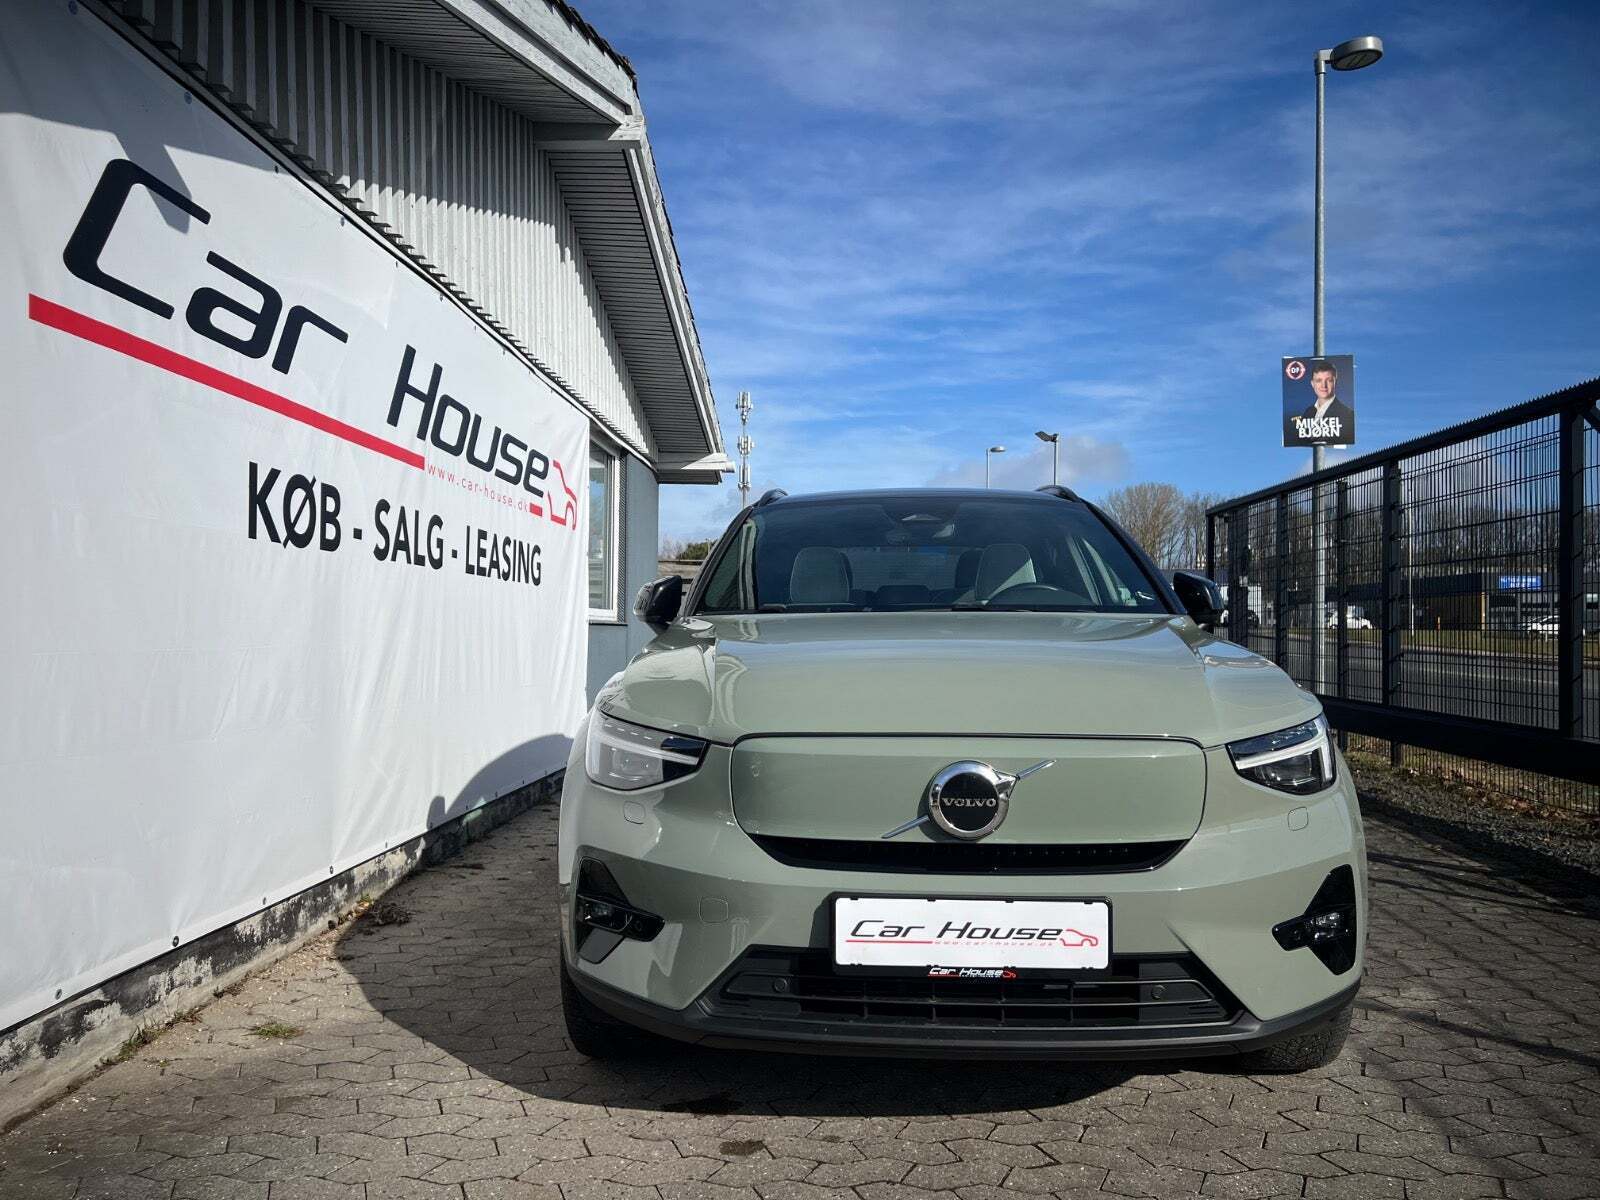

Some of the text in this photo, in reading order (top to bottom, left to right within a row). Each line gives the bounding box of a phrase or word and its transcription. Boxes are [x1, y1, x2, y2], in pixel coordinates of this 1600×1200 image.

[63, 158, 549, 498] Car House
[1296, 417, 1342, 430] MIKKEL
[1298, 427, 1340, 438] BJØRN
[248, 461, 342, 551] KØB
[374, 499, 444, 570] SALG
[465, 525, 542, 586] LEASING
[941, 797, 997, 807] VOLVO
[850, 920, 1063, 940] Car House
[930, 967, 956, 976] Car
[960, 967, 1003, 977] House
